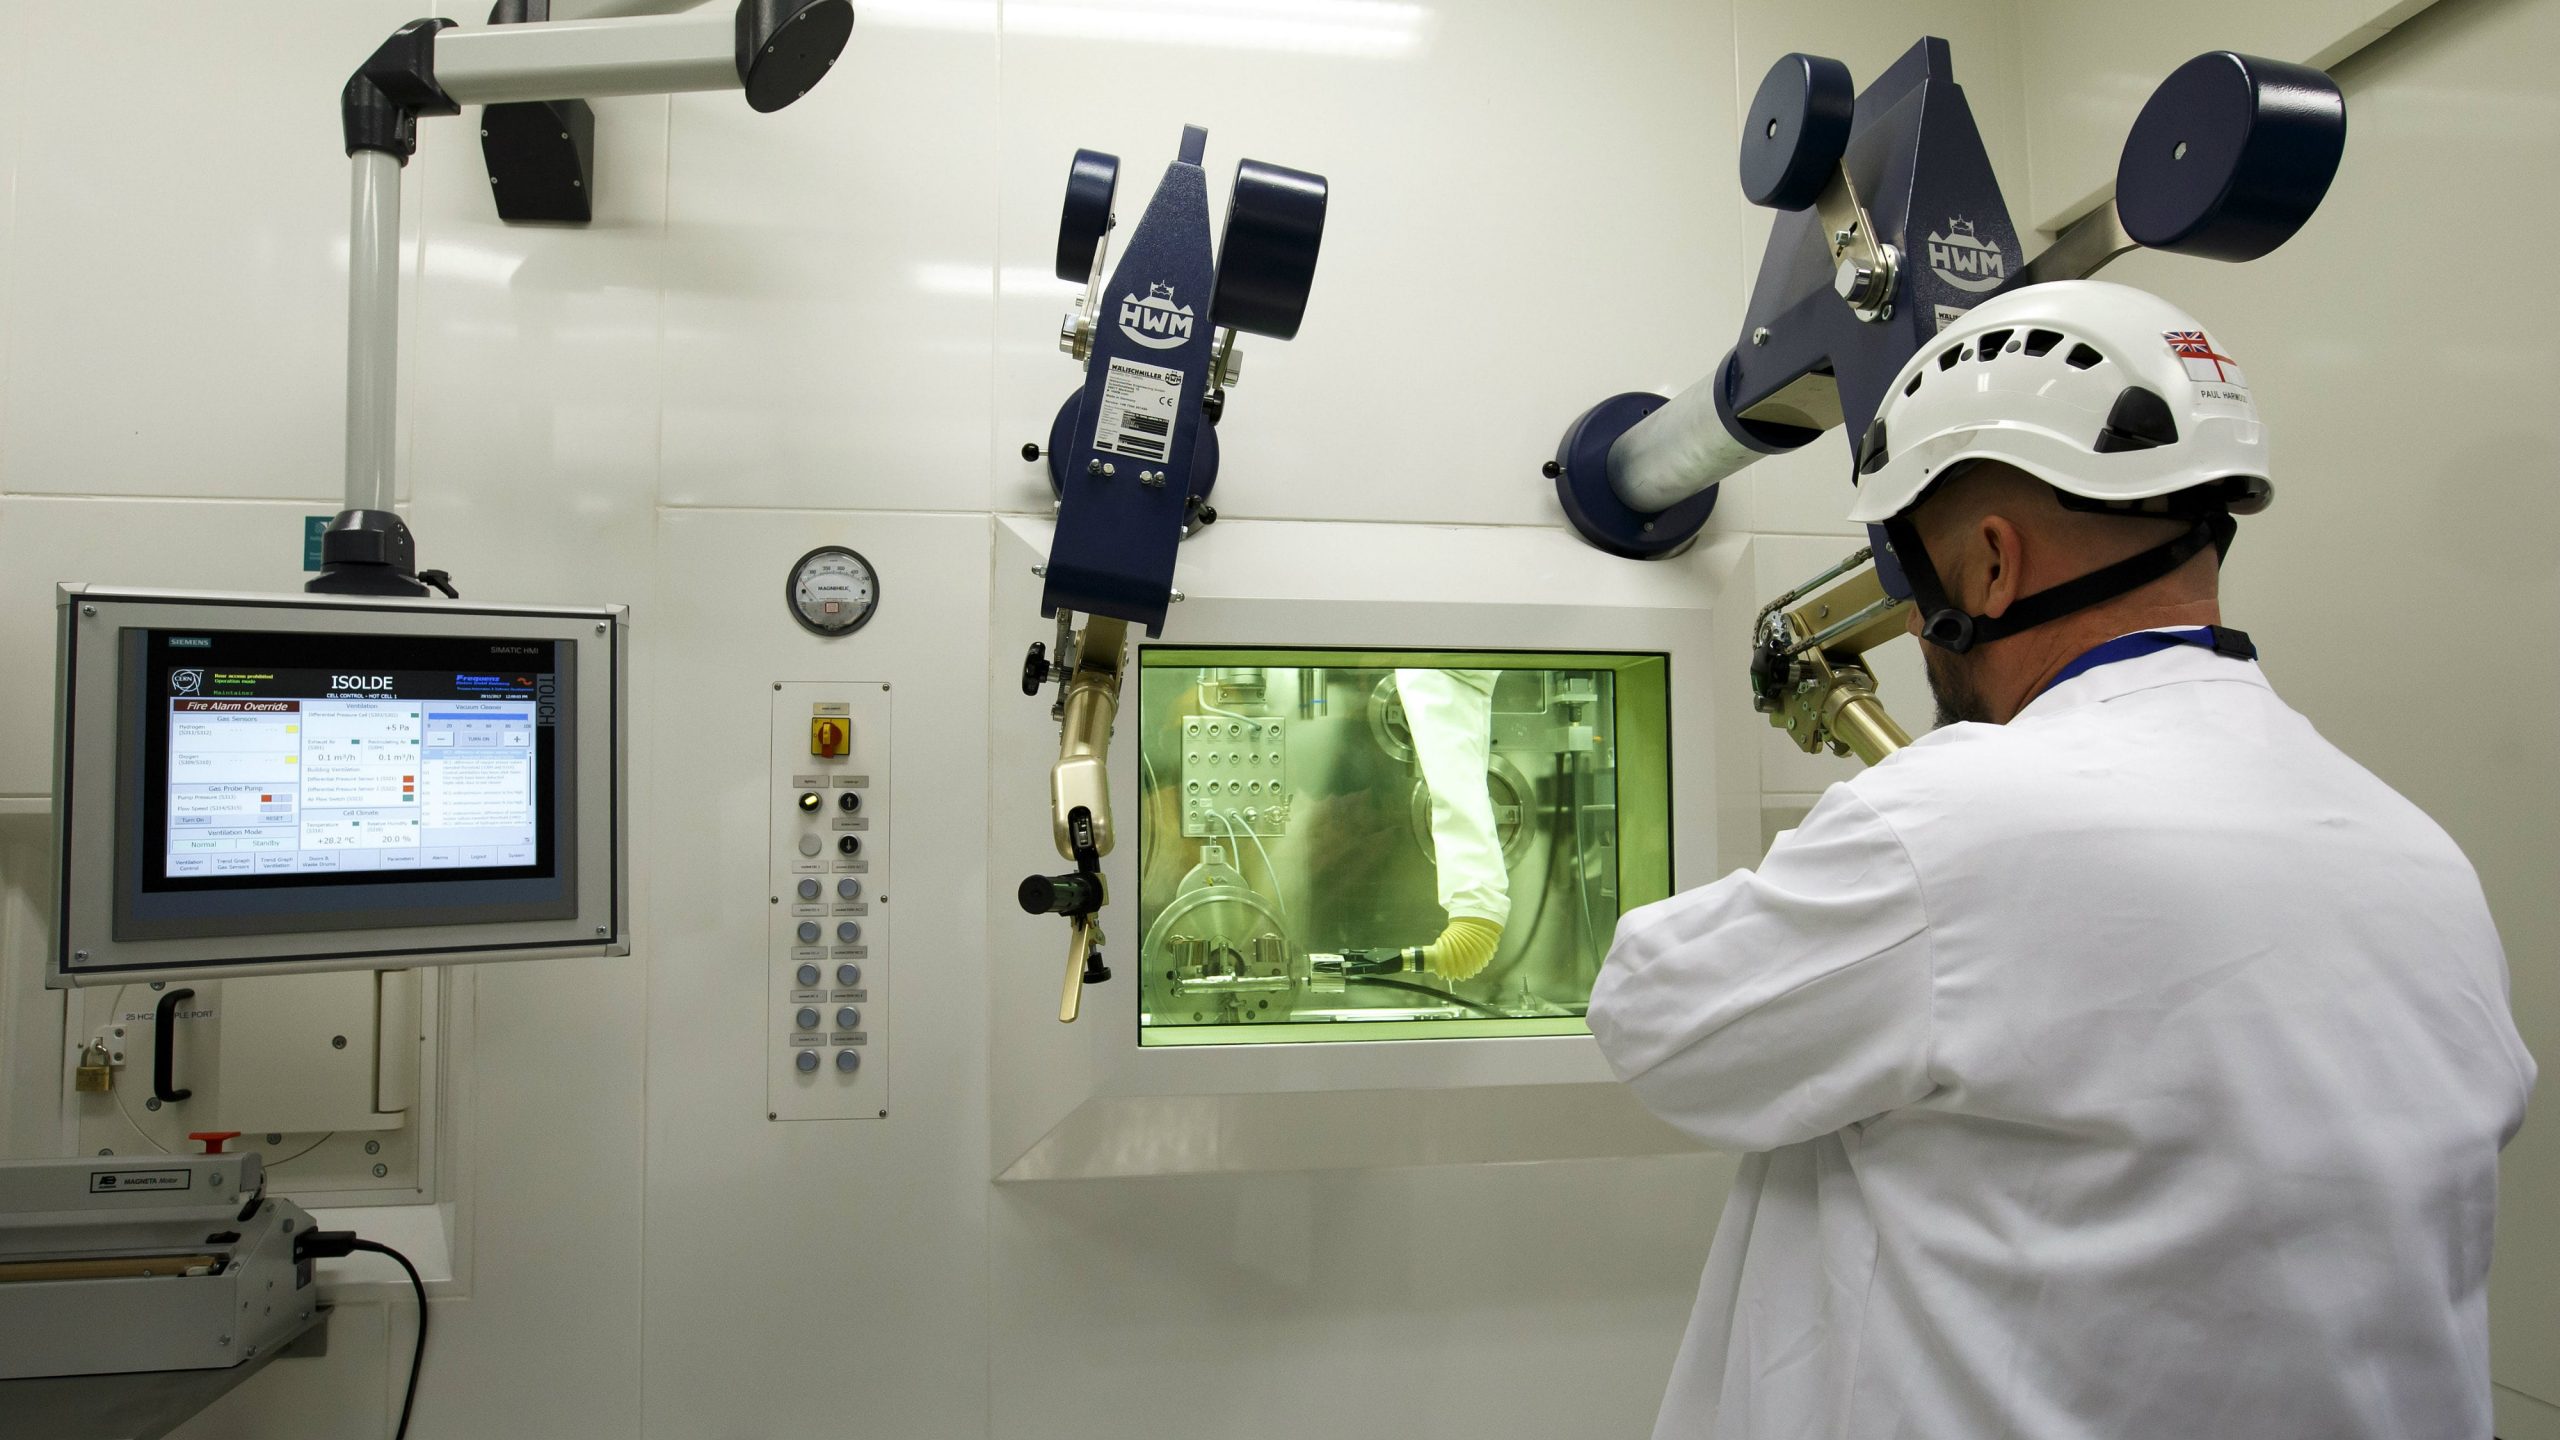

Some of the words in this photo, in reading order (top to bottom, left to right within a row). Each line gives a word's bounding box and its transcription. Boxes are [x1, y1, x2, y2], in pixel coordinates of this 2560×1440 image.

[1928, 242, 2005, 278] HWM
[1119, 302, 1194, 339] HWM
[2201, 390, 2221, 399] PAUL
[1159, 396, 1173, 407] CE
[170, 638, 209, 647] SIEMENS
[331, 675, 393, 690] ISOLDE
[538, 675, 556, 725] TOUCH
[186, 702, 208, 710] Fire
[210, 702, 242, 711] Alarm
[244, 702, 288, 712] Override
[318, 836, 342, 845] +28.2
[382, 836, 400, 844] 20.0
[126, 1013, 136, 1021] 25
[138, 1012, 154, 1020] HC2
[192, 1010, 213, 1018] PORT
[124, 1177, 158, 1185] MAGNETA
